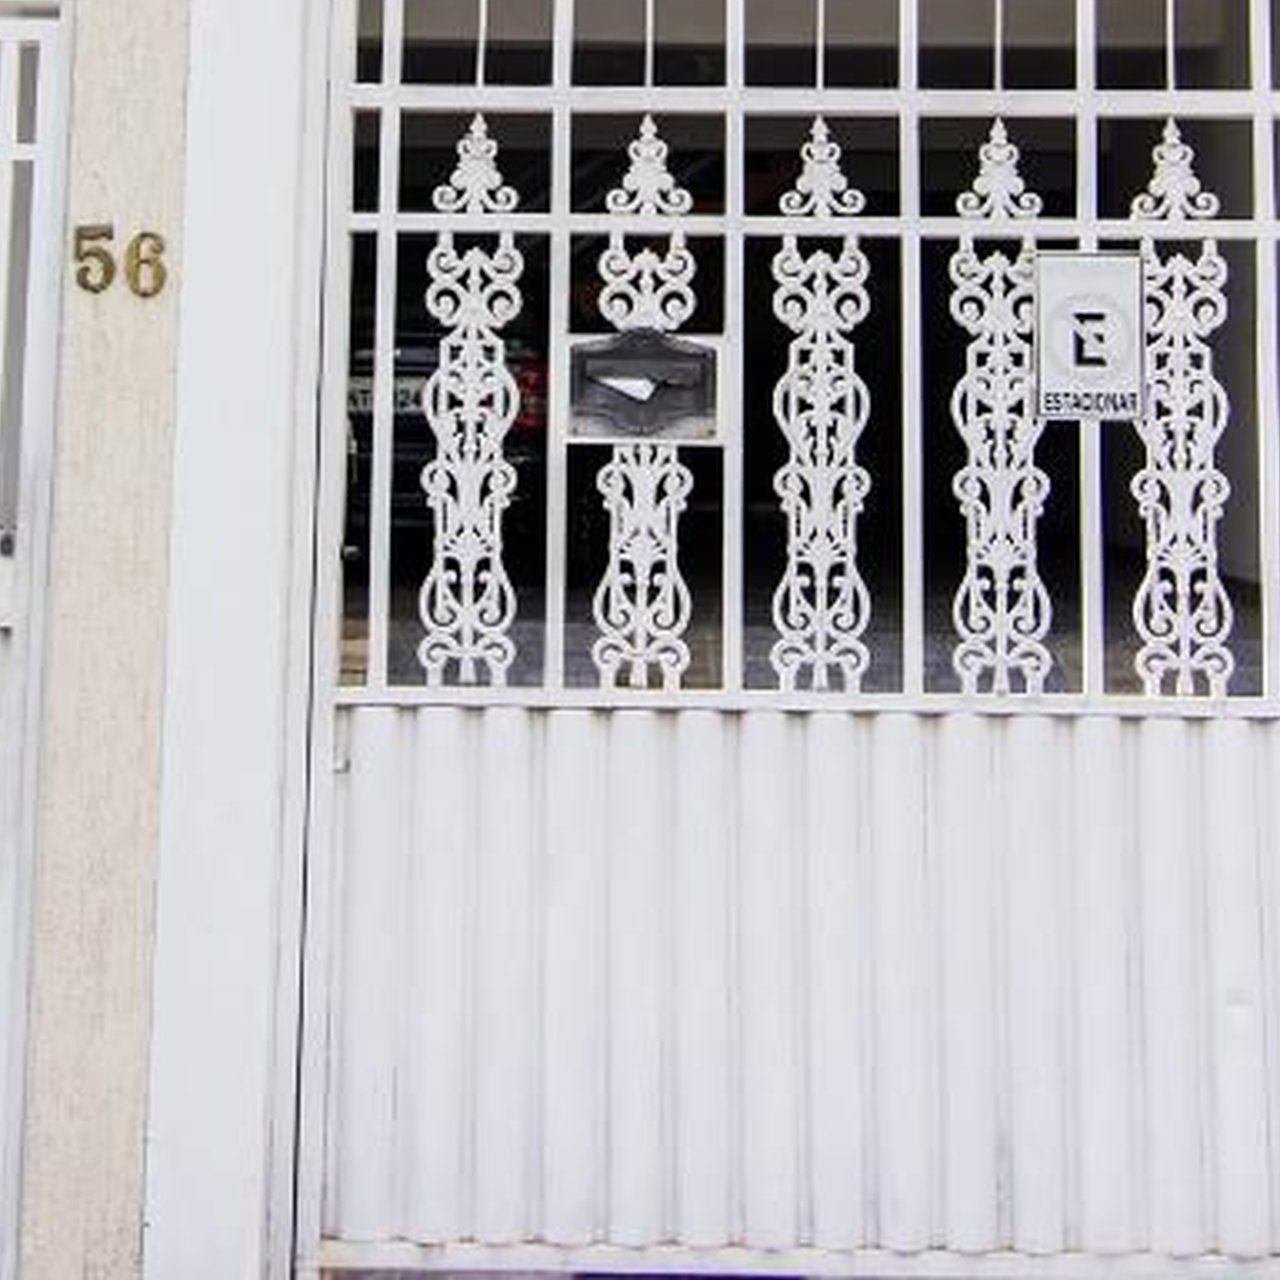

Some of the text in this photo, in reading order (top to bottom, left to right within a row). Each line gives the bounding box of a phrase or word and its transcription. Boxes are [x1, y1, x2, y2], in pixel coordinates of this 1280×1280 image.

[75, 225, 167, 299] 56
[1073, 312, 1107, 367] E
[1045, 392, 1138, 413] ESTACIONAR
